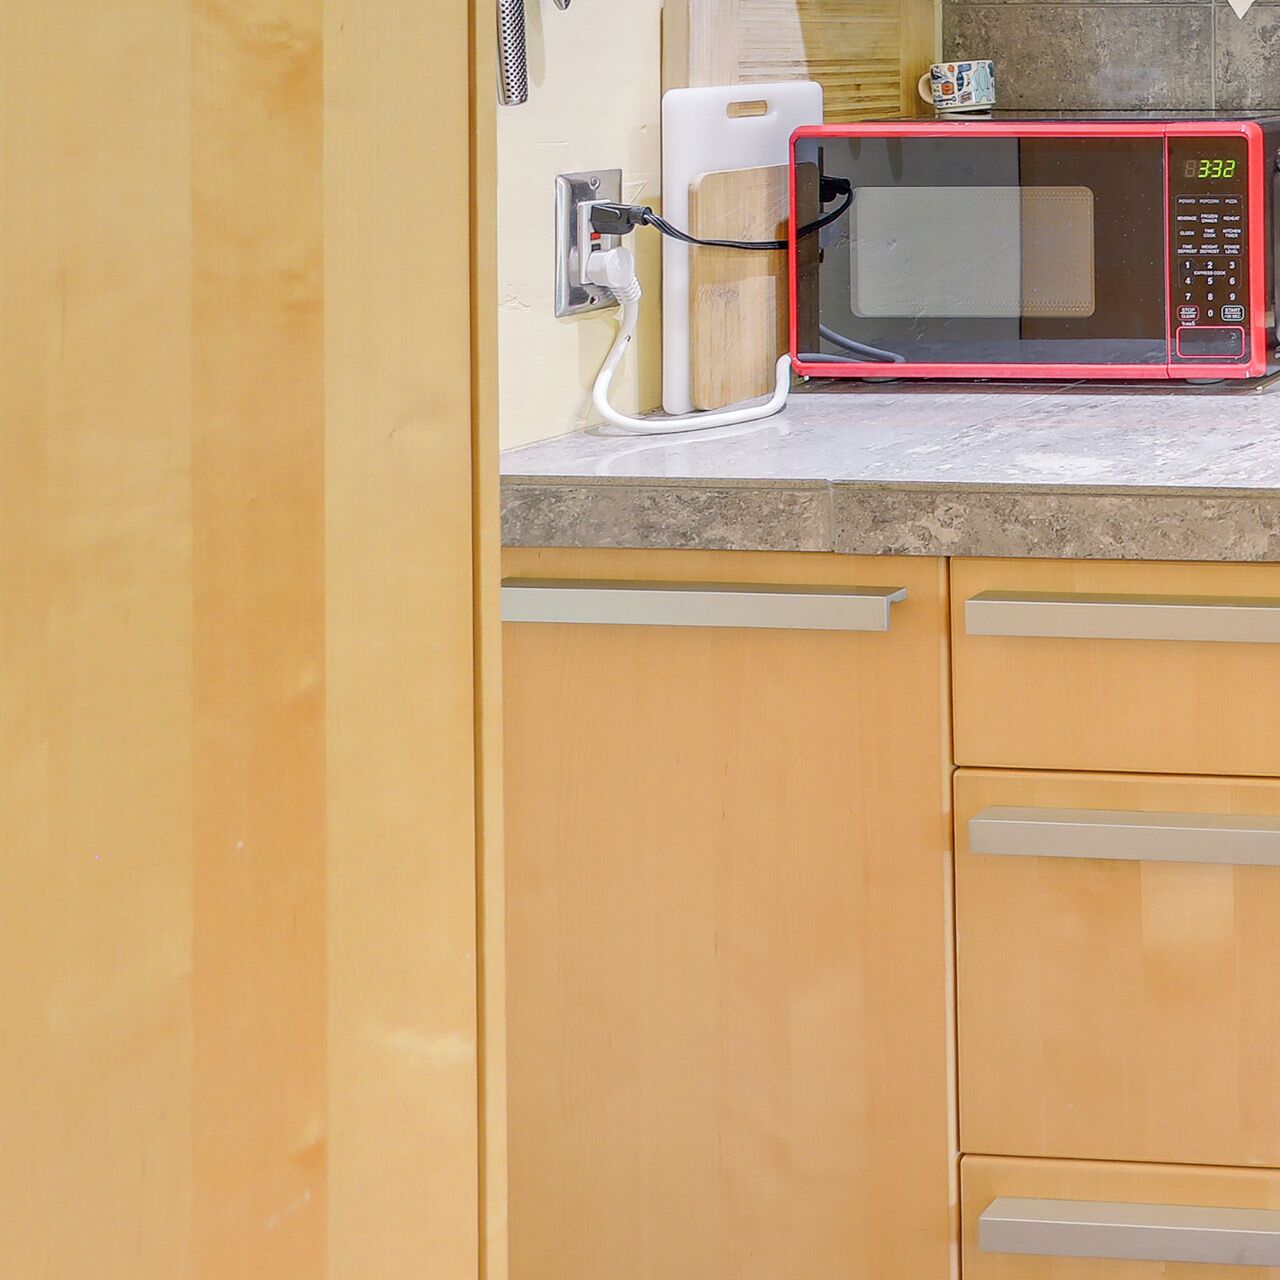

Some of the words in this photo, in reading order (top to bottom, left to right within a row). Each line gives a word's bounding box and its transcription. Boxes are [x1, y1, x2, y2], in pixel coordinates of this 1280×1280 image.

[1198, 160, 1236, 178] 3:32
[1185, 261, 1190, 269] 1
[1207, 261, 1213, 269] 2
[1229, 261, 1235, 269] 3
[1185, 277, 1191, 285] 4
[1207, 277, 1213, 285] 5
[1229, 277, 1236, 285] 6
[1207, 293, 1213, 301] 8
[1229, 293, 1236, 301] 9
[1207, 309, 1214, 317] 0
